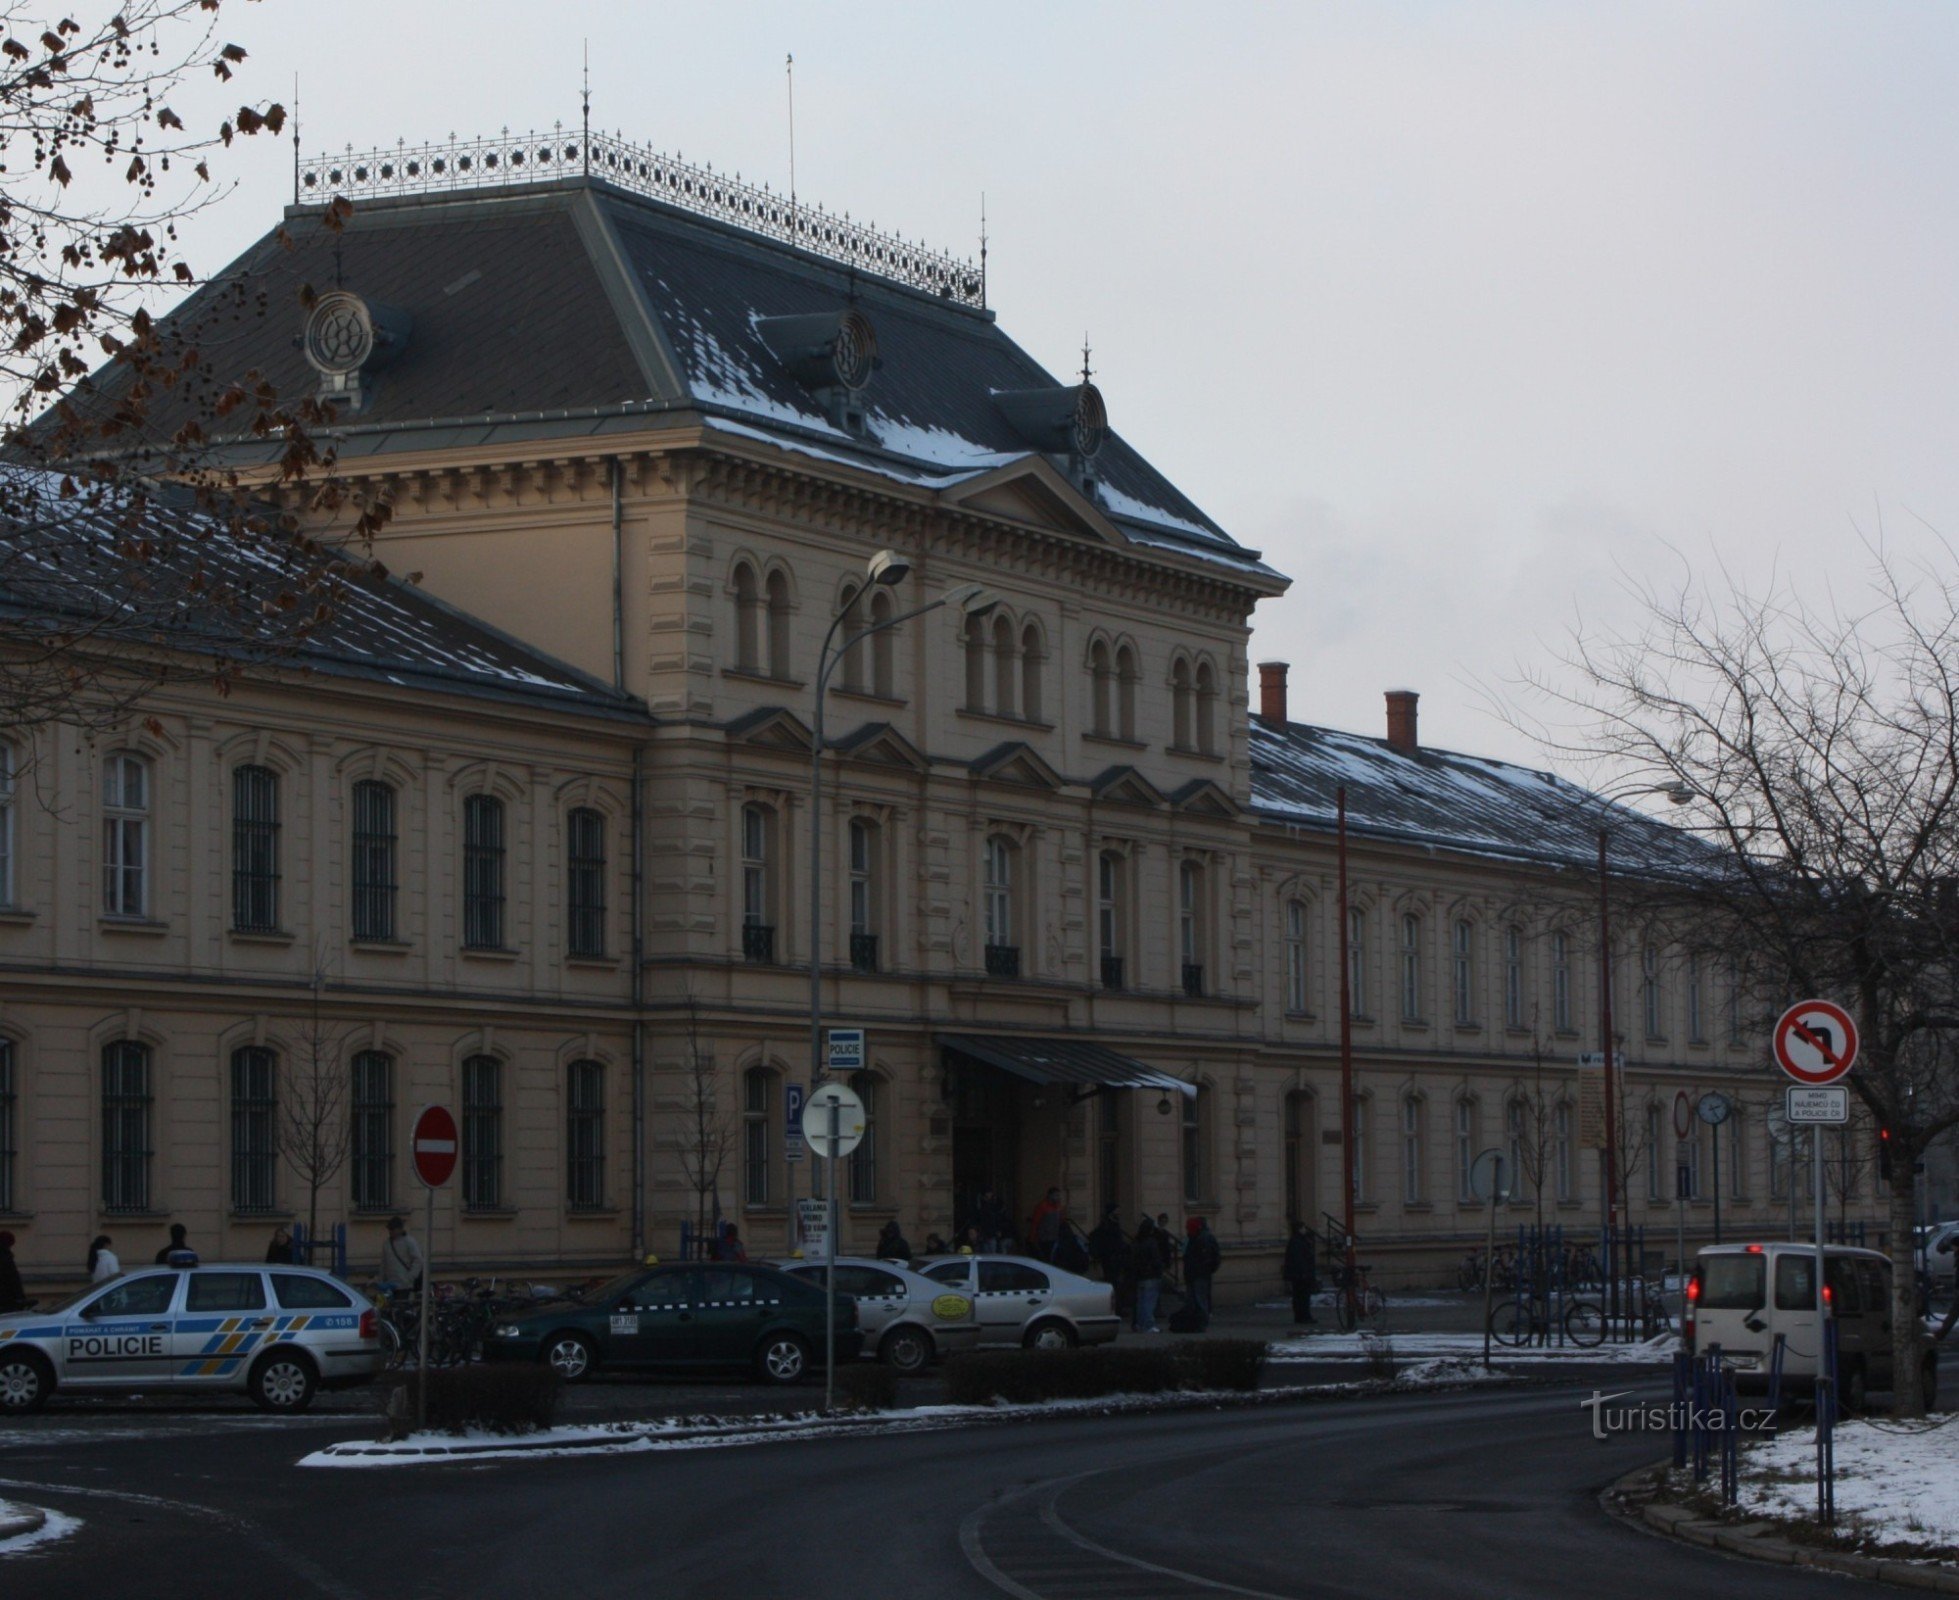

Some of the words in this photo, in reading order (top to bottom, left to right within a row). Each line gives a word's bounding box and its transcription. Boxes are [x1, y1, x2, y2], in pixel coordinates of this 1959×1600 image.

[830, 1043, 860, 1055] POLICIE
[789, 1090, 800, 1120] P
[1802, 1109, 1828, 1117] POLICIE
[335, 1317, 352, 1326] 158
[70, 1336, 162, 1356] POLICIE
